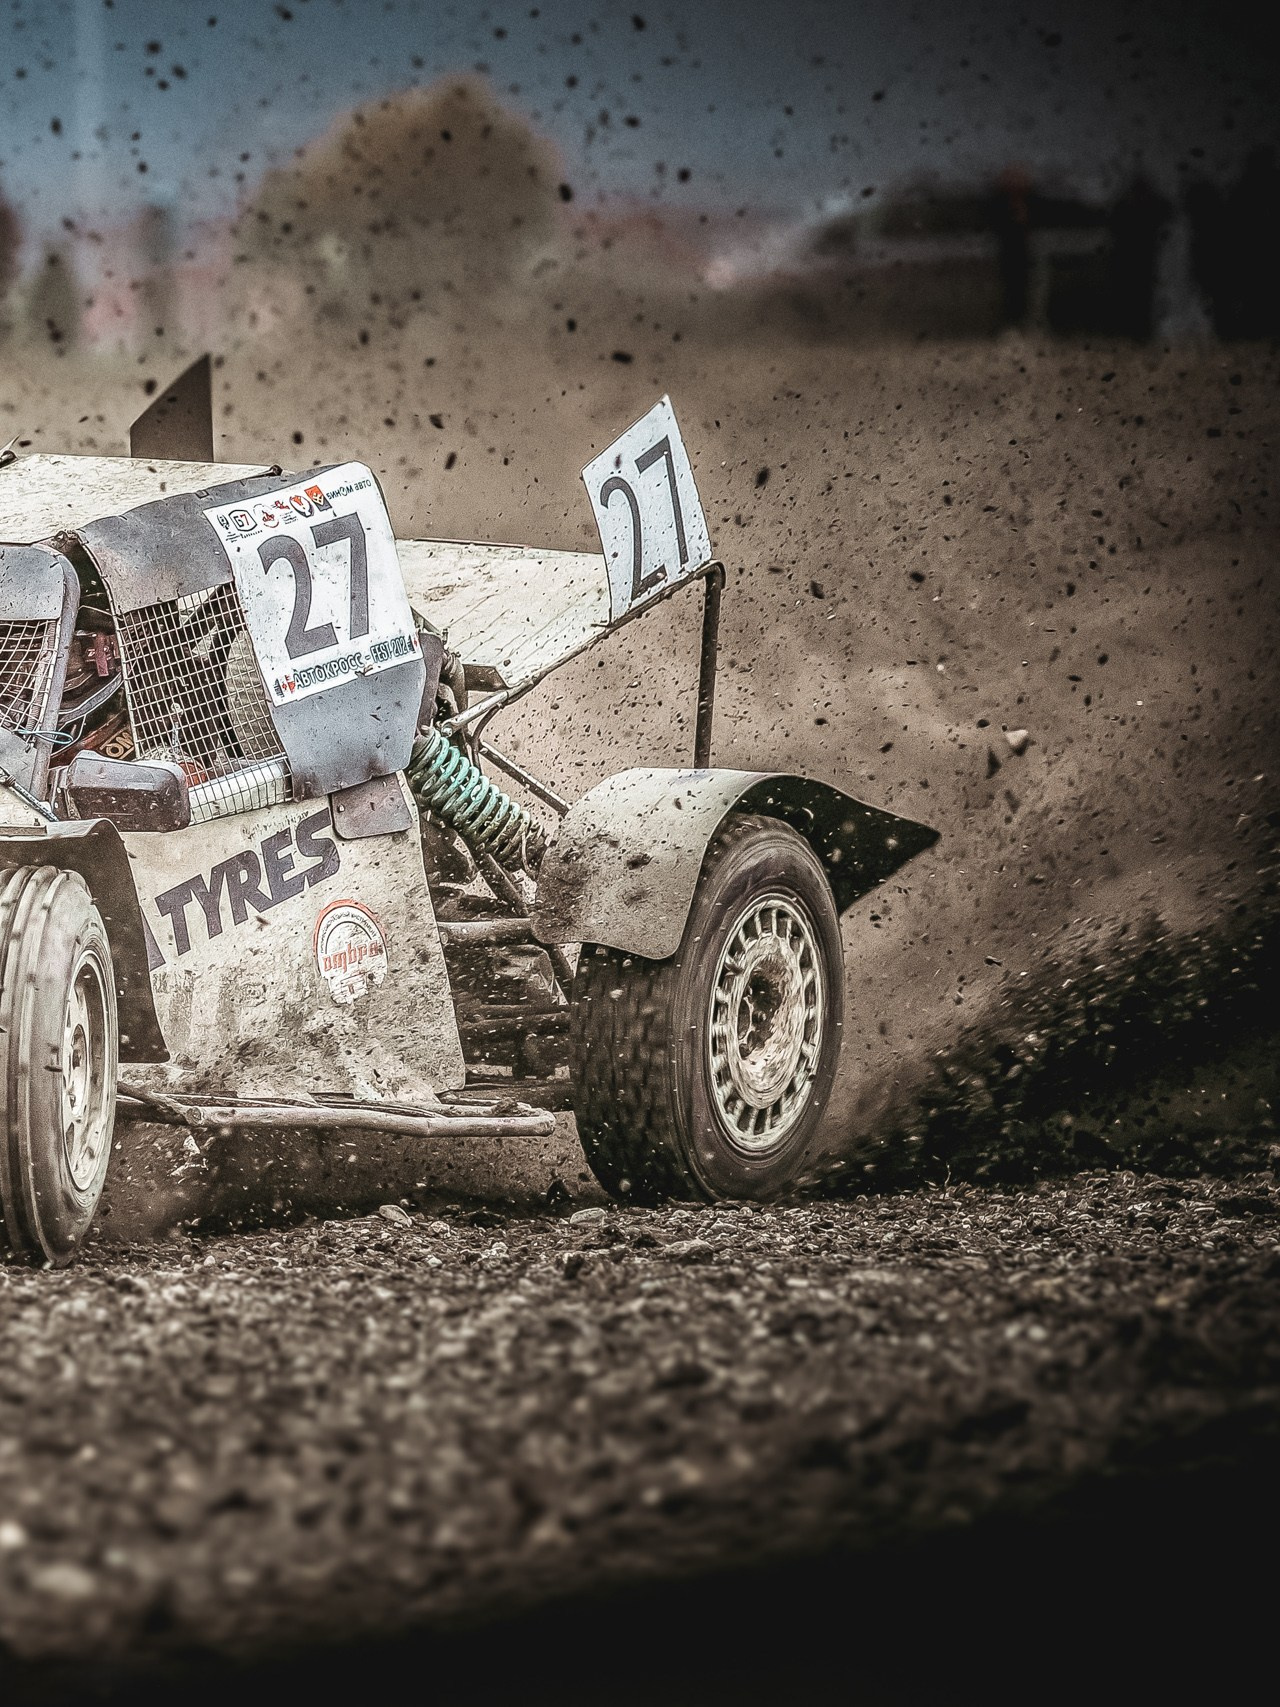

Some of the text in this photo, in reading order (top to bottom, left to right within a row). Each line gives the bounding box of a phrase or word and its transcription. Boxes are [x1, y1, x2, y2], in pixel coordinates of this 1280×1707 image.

[257, 511, 370, 660] 27
[600, 434, 689, 601] 27
[293, 652, 365, 689] АВТОКРОСС
[154, 806, 341, 957] TYRES
